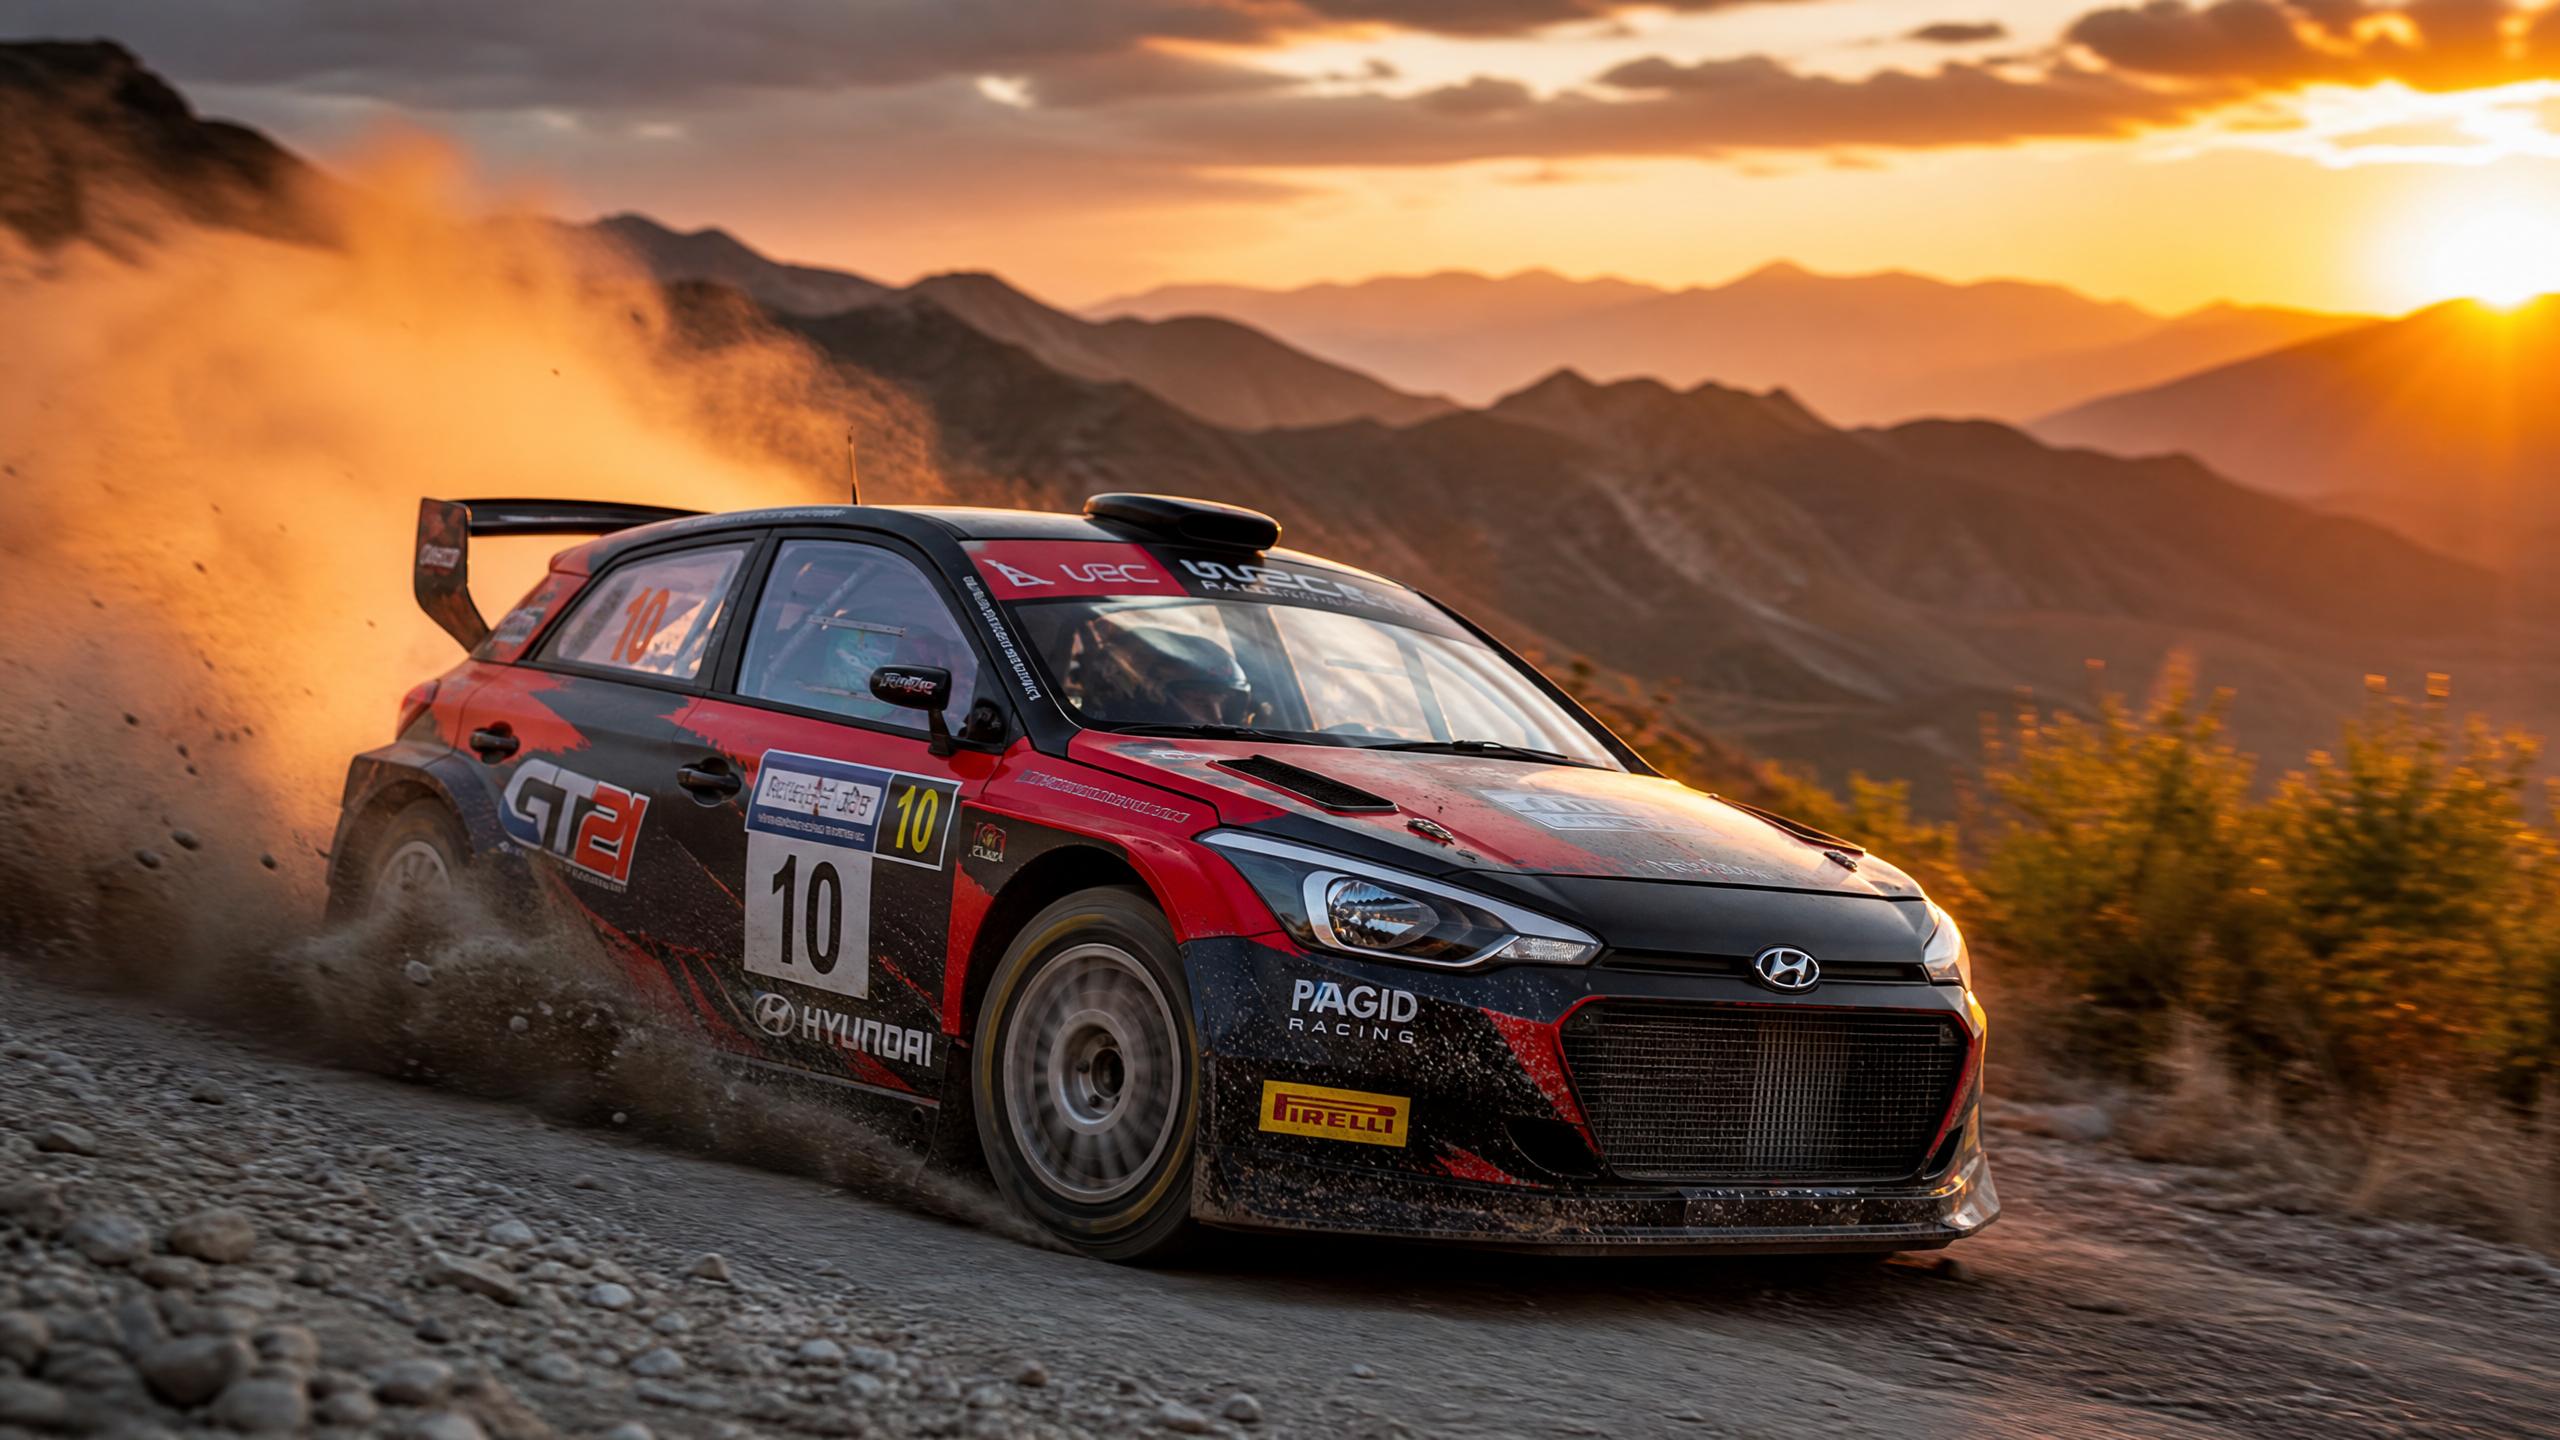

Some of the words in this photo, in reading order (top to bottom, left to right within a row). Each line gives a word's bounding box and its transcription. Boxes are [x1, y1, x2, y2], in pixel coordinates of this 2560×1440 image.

[611, 587, 670, 664] 10
[499, 758, 650, 885] GT21
[896, 784, 939, 854] 10
[772, 854, 842, 975] 10
[1288, 1018, 1414, 1044] RACING
[1291, 978, 1418, 1023] PAGID
[802, 1005, 933, 1067] HYUNDAI
[1273, 1092, 1397, 1134] PIRELLI
